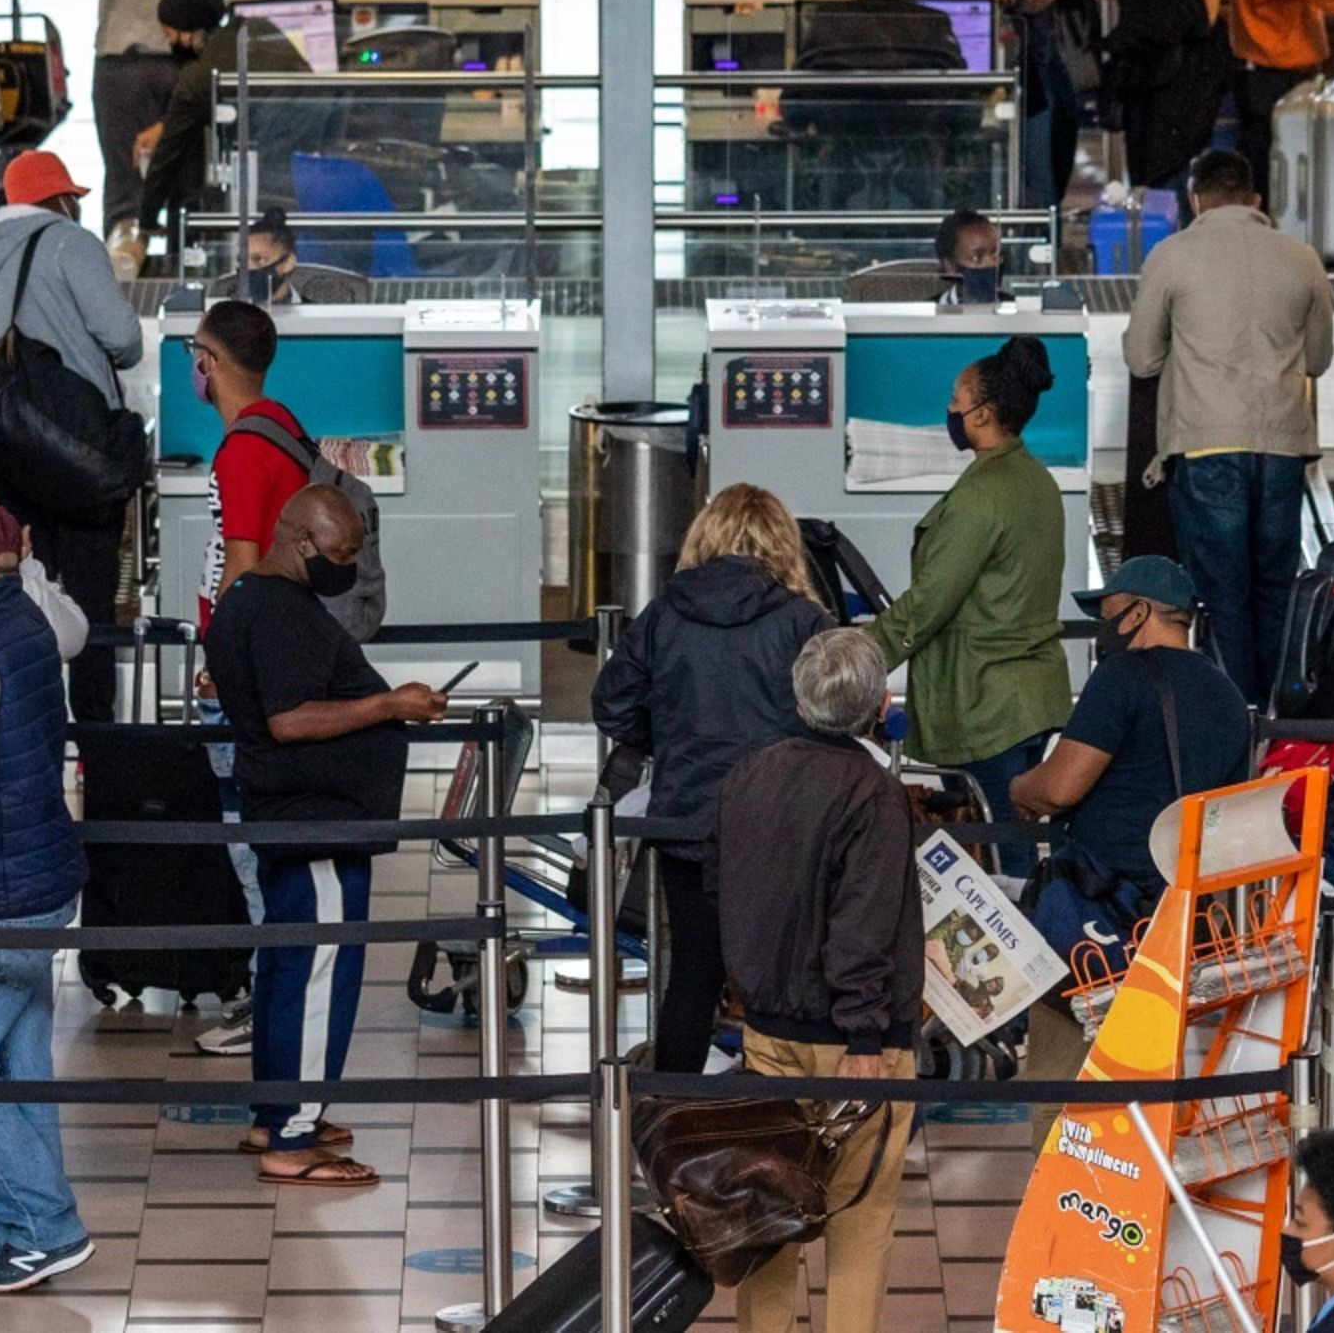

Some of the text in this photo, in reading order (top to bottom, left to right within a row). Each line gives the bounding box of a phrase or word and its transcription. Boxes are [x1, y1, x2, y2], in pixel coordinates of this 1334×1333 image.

[930, 850, 950, 868] CT
[954, 874, 1020, 951] CAPE TIMES
[1058, 1137, 1141, 1179] Compliments
[1058, 1189, 1144, 1248] mango
